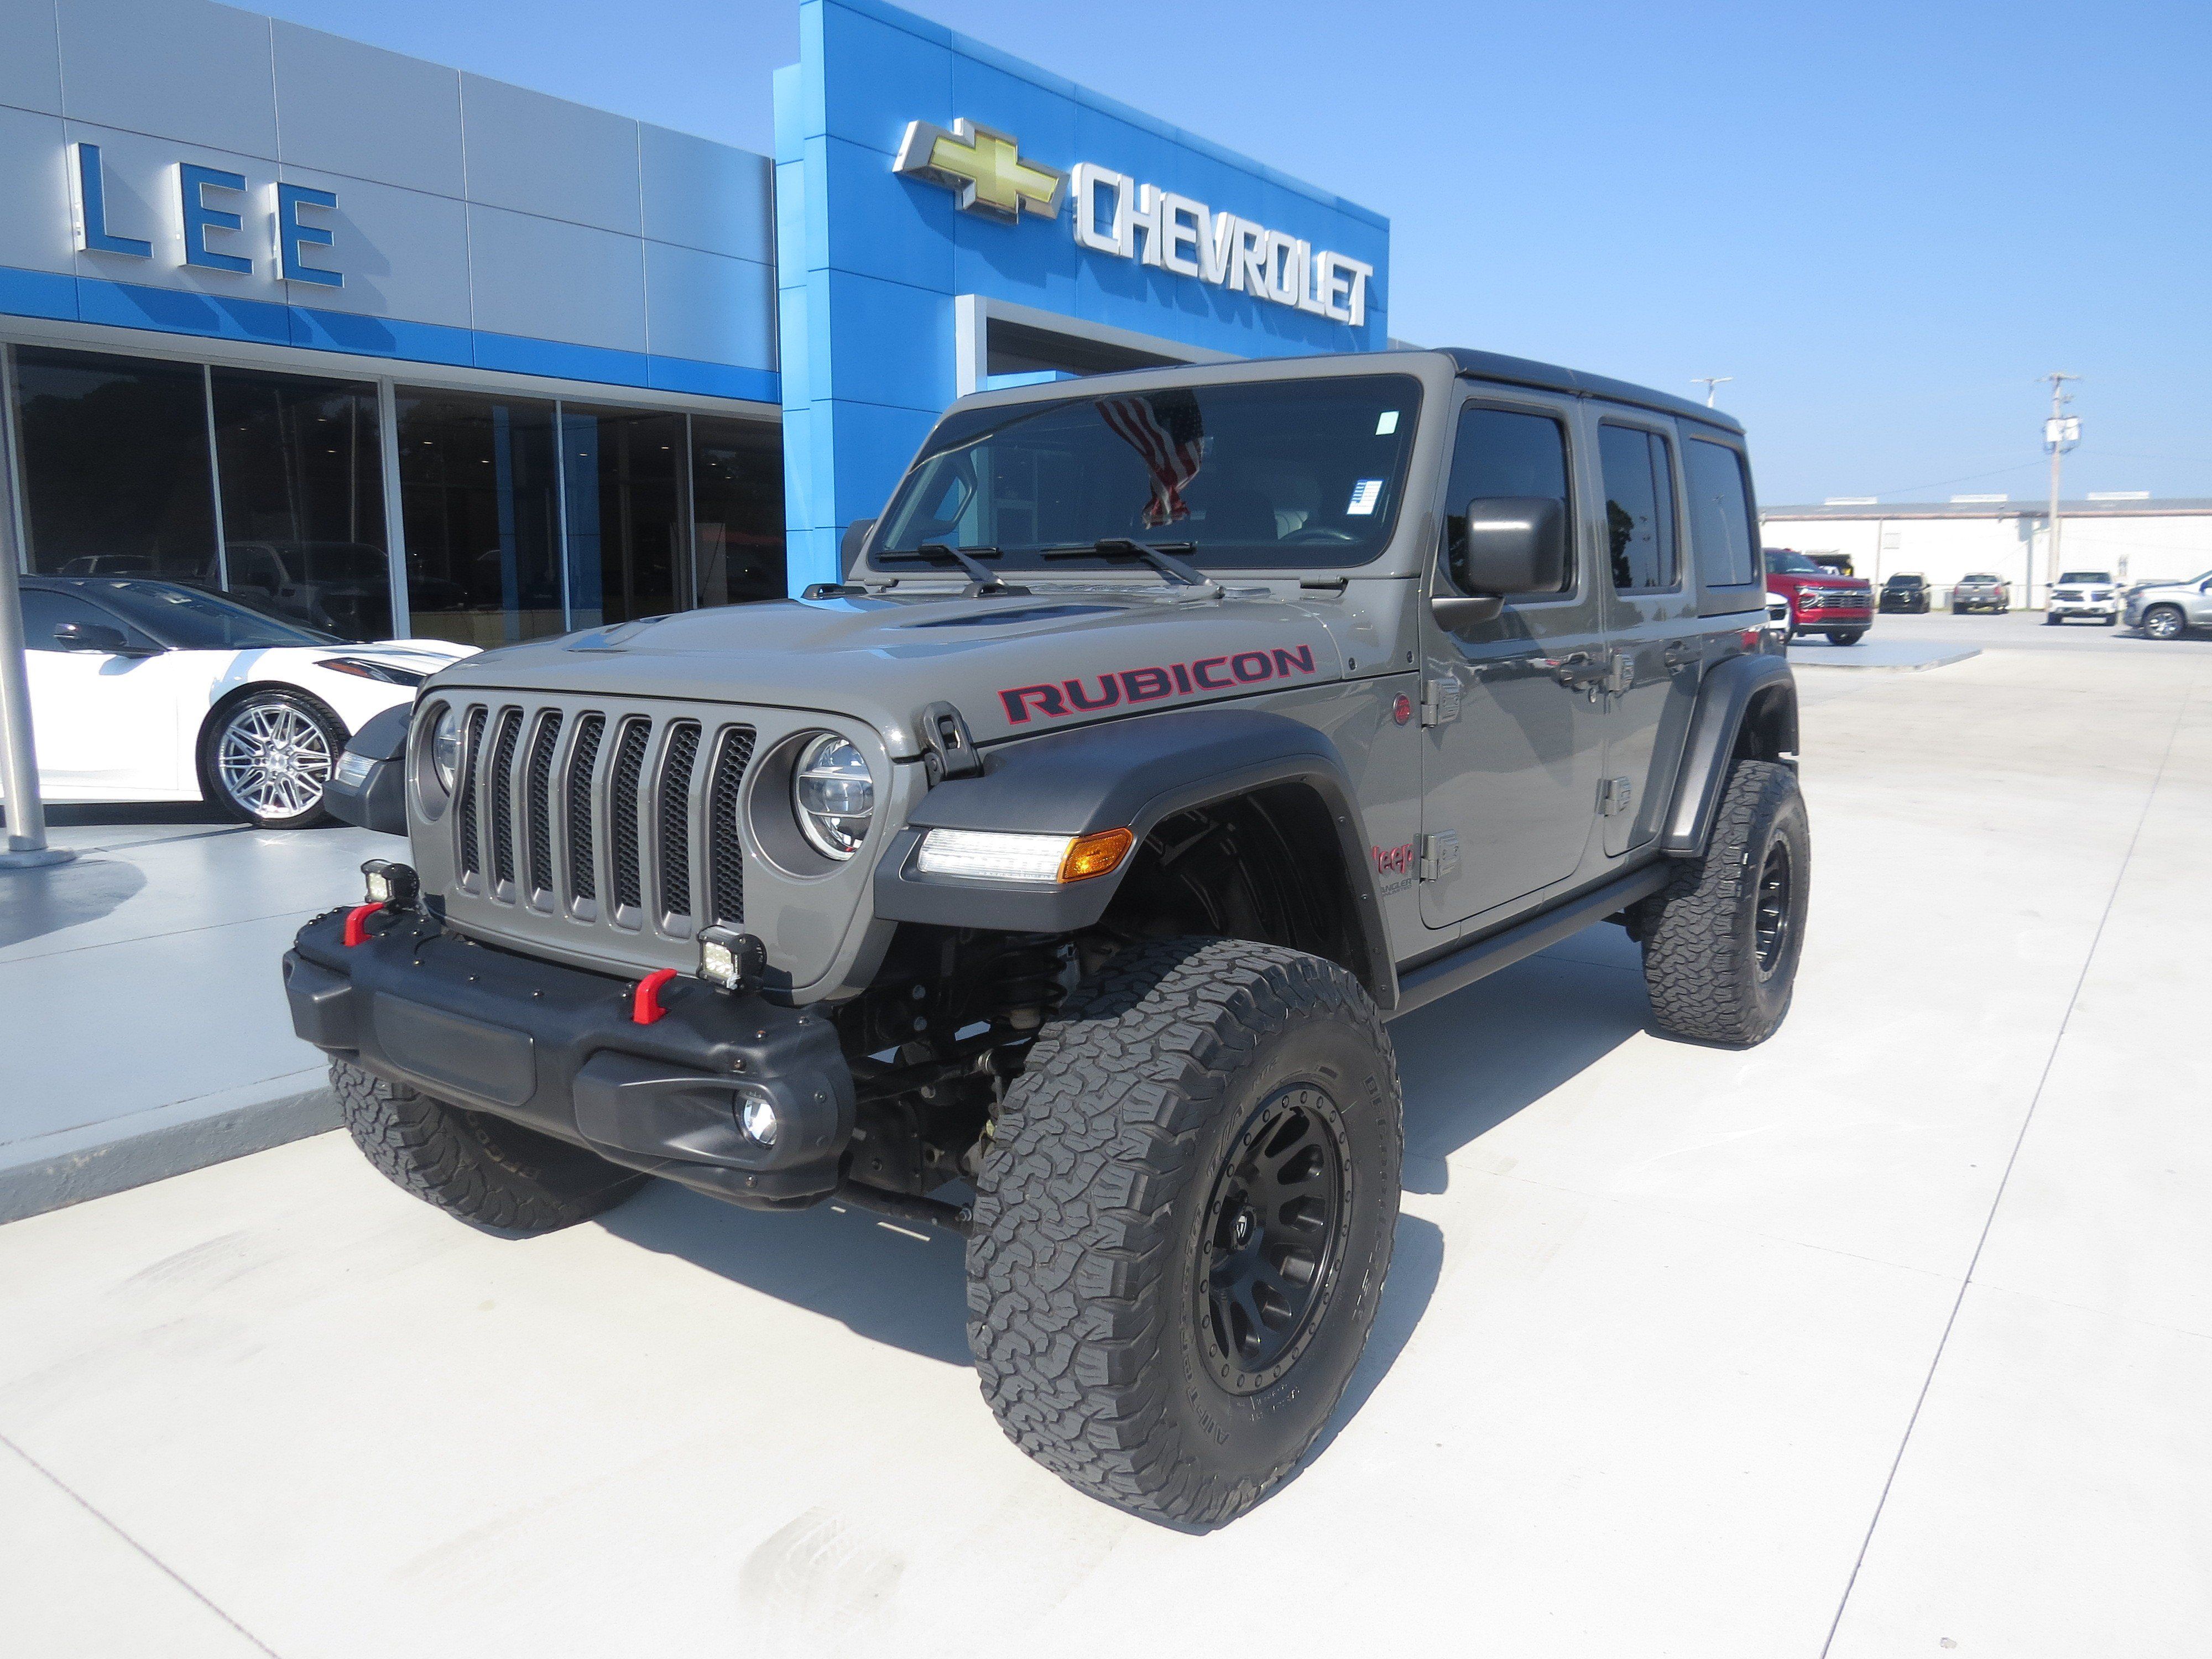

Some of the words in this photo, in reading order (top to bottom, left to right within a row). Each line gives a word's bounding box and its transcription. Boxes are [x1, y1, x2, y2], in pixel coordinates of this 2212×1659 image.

[75, 142, 345, 288] LEE
[1071, 162, 1374, 327] CHEVROLET
[997, 644, 1316, 725] RUBICON
